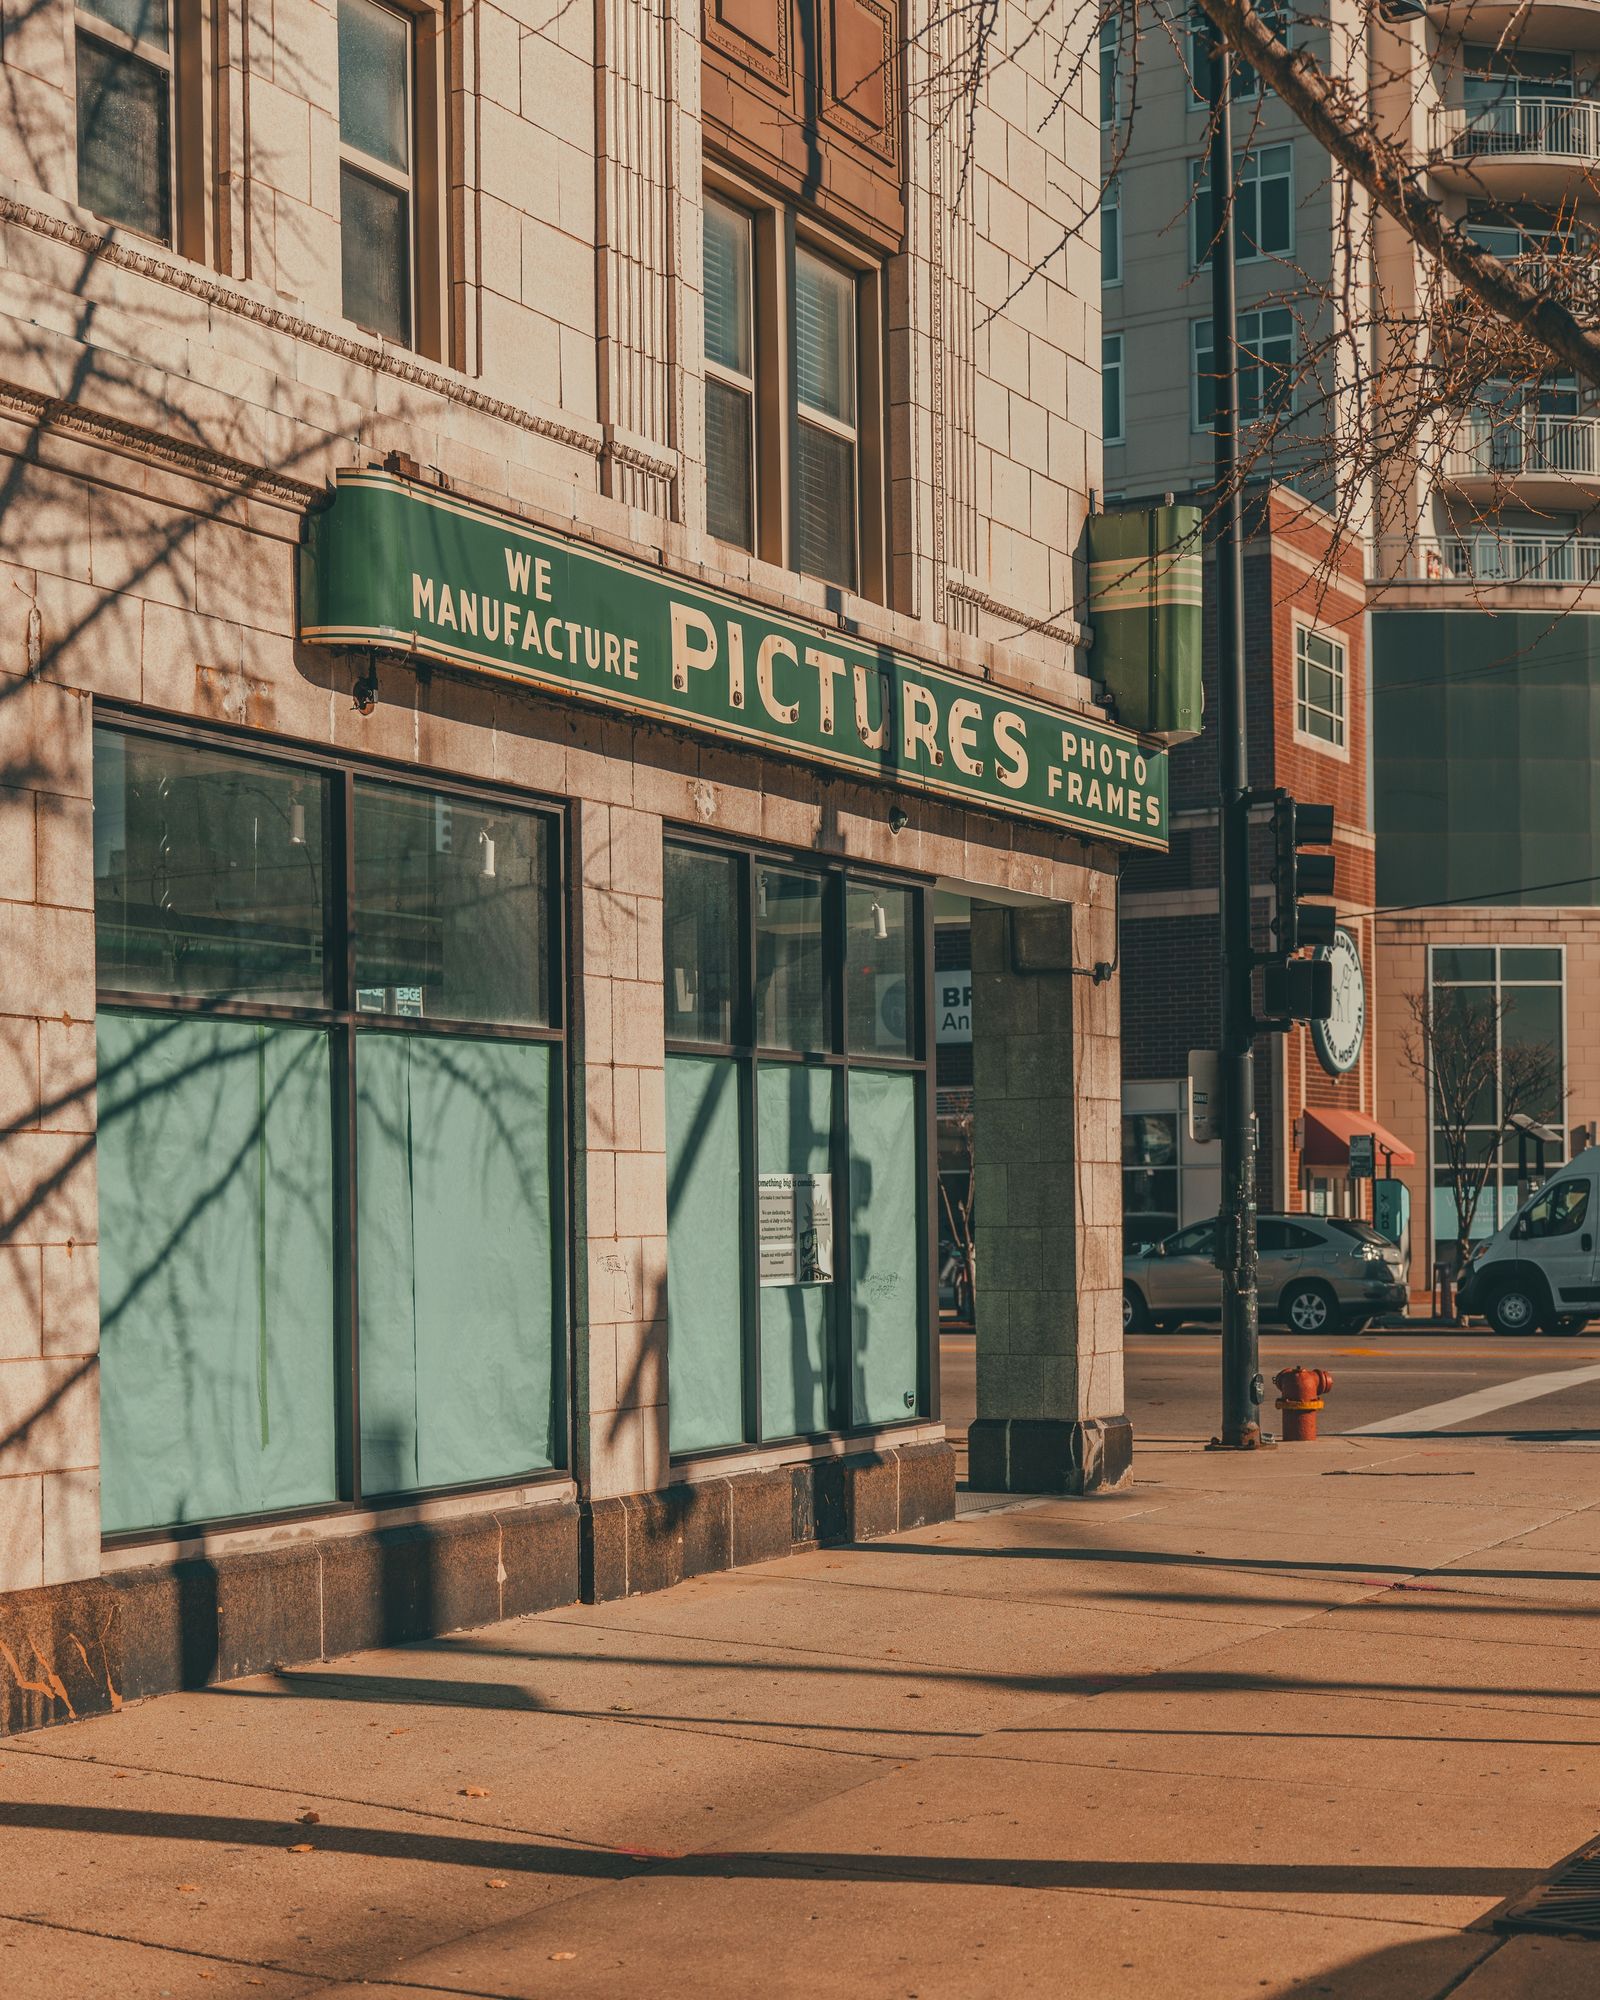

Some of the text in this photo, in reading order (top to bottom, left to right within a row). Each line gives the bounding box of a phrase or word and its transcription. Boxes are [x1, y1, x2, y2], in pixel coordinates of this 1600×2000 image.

[504, 547, 552, 602] WE
[412, 573, 640, 681] MANUFACTURE
[669, 601, 1030, 790] PICTURES
[1061, 730, 1148, 786] PHOTO
[1047, 765, 1161, 827] FRAMES
[1338, 1002, 1363, 1063] HOSPITAL
